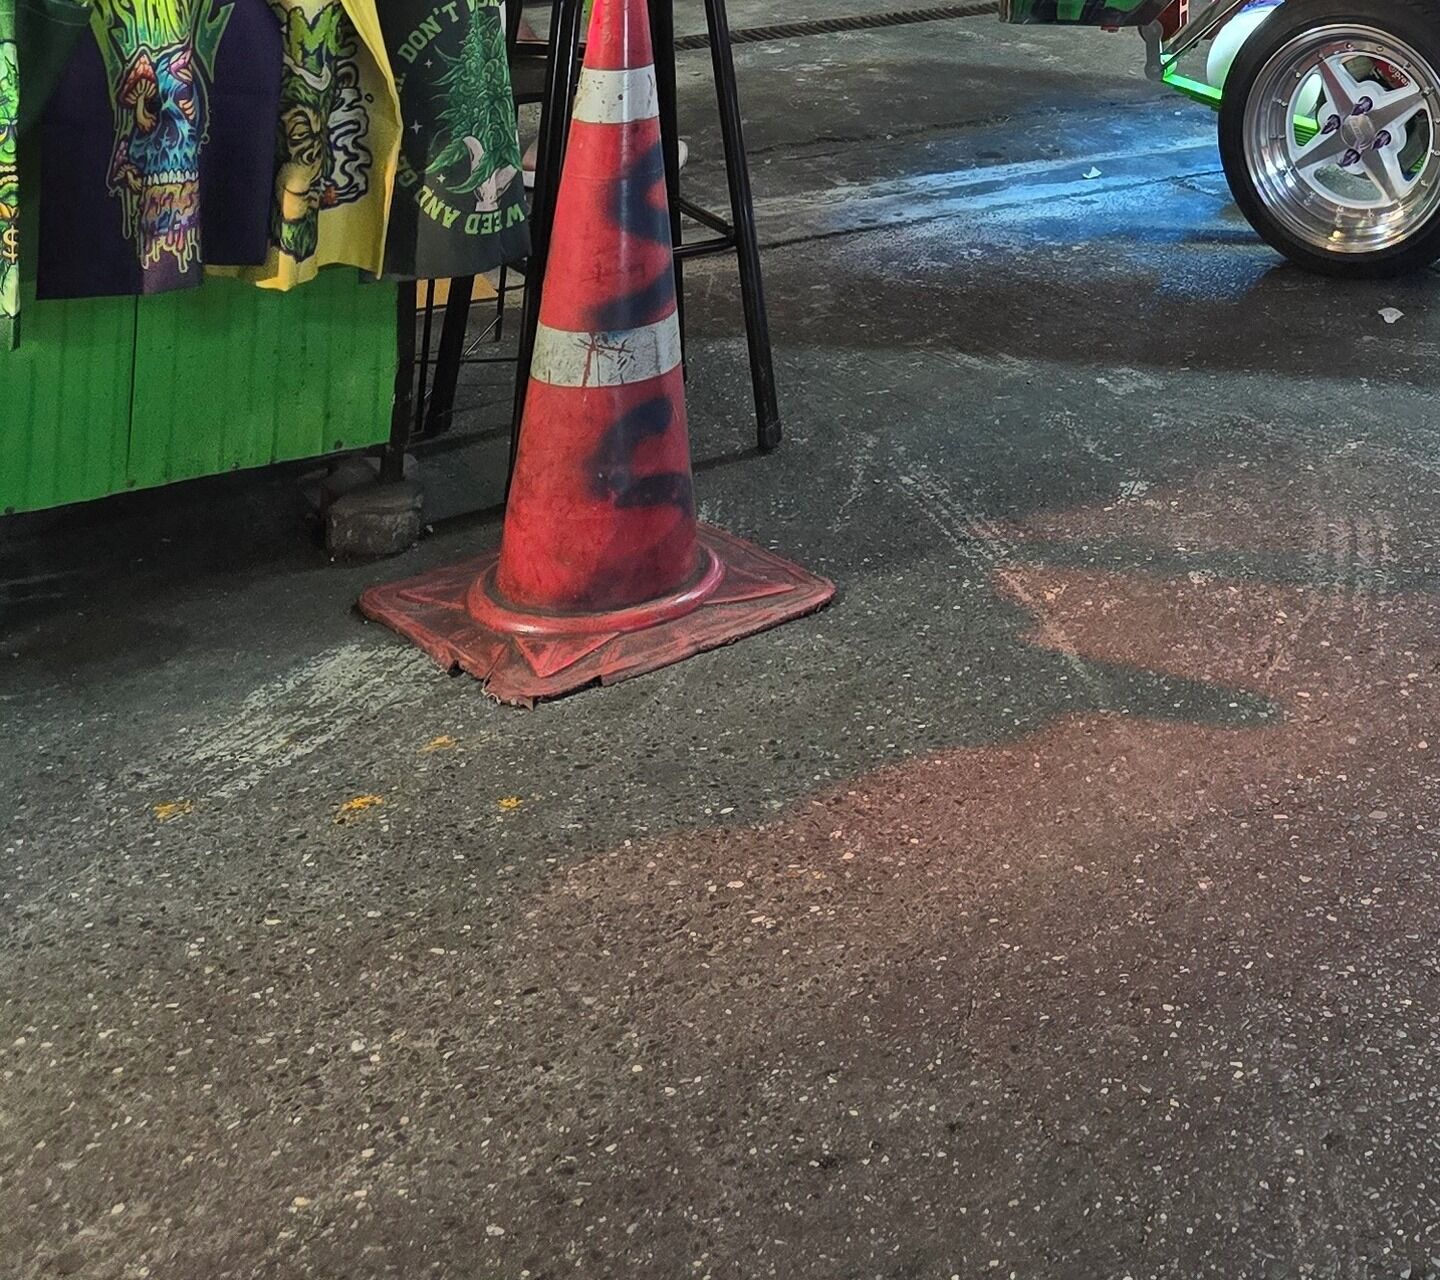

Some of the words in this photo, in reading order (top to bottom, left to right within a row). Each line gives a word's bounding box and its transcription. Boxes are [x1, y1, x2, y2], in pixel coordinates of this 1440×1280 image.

[397, 1, 458, 63] DON'T
[419, 184, 462, 229] AND
[464, 202, 525, 235] WEED
